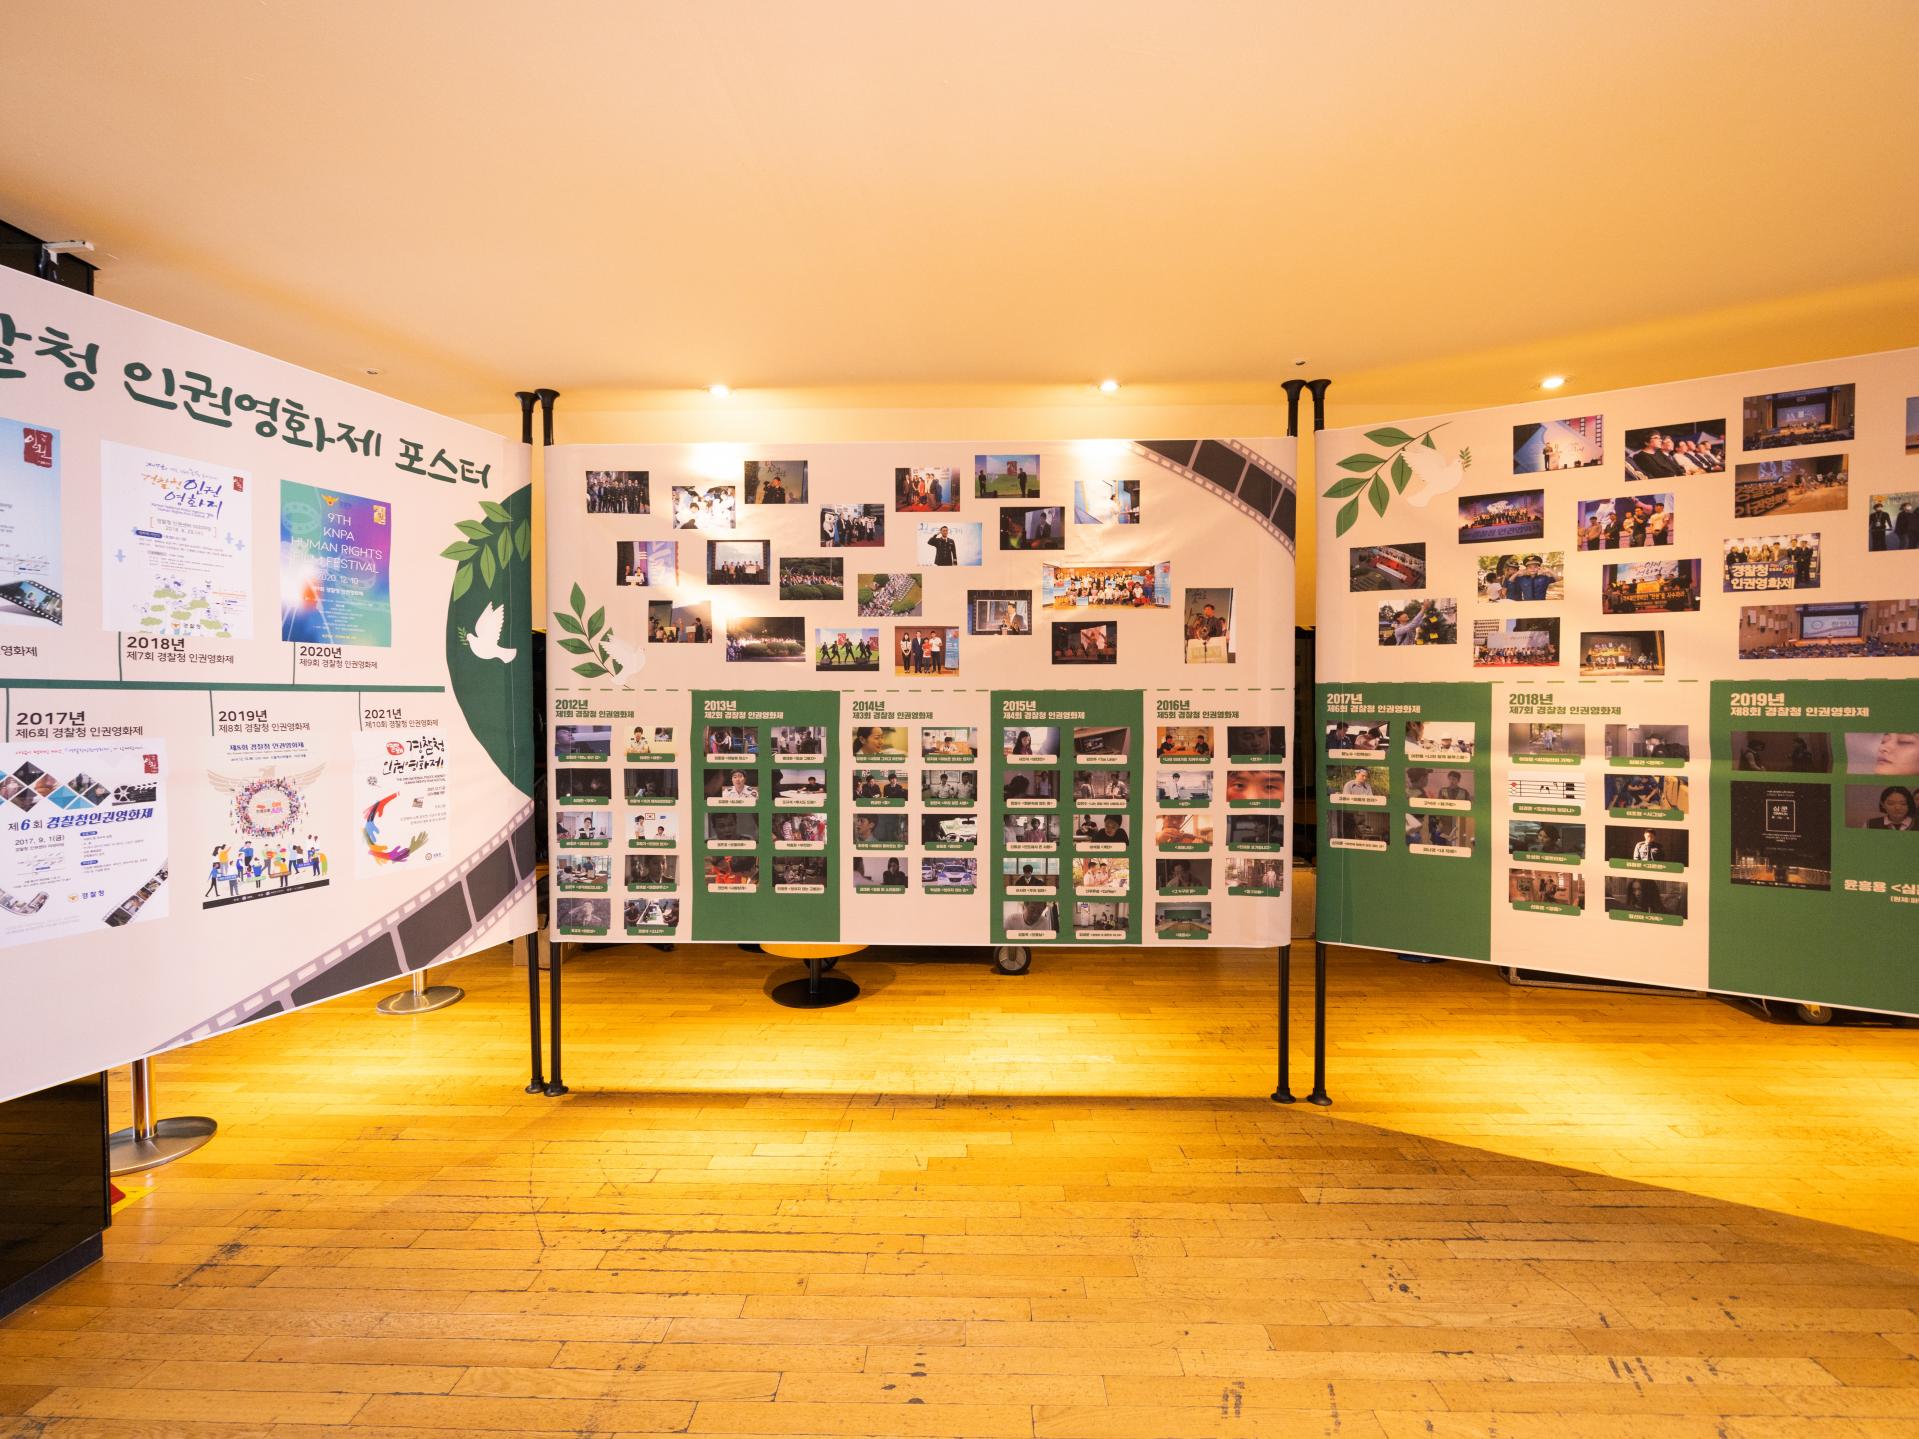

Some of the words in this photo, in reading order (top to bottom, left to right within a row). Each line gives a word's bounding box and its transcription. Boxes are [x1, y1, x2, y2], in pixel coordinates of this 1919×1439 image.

[124, 362, 382, 457] 인권영화제
[395, 438, 491, 488] 포스터
[184, 480, 222, 497] 인권
[165, 491, 222, 520] 영화제
[327, 512, 351, 526] 9TH
[323, 527, 355, 541] KNPA
[291, 536, 338, 553] HUMAN
[341, 544, 383, 560] RIGHTS
[326, 556, 379, 573] FESTIVAL
[1732, 564, 1769, 577] 경찰청
[1731, 577, 1796, 589] 인권영화제
[127, 637, 185, 651] 2018년
[0, 645, 38, 657] 영화제
[300, 646, 341, 659] 2020년
[126, 651, 154, 661] 제7회
[157, 652, 186, 663] 경찰청
[188, 653, 234, 664] 인권영화제
[299, 658, 320, 667] 제9회
[322, 659, 343, 668] 경찰청
[345, 660, 378, 669] 인권영화제
[1327, 693, 1362, 704] 2017년
[1509, 693, 1553, 705] 2018년
[1730, 693, 1784, 706] 2019년
[555, 700, 588, 710] 2012년
[704, 701, 736, 711] 2013년
[852, 701, 885, 711] 2014년
[1003, 701, 1036, 711] 2015년
[1157, 700, 1190, 710] 2016년
[1327, 705, 1348, 713] 제6회
[1350, 705, 1375, 713] 경찰청
[1378, 705, 1421, 713] 인권영화제
[1509, 706, 1534, 714] 제7회
[1536, 706, 1566, 715] 경찰청
[1569, 706, 1621, 715] 인권영화제
[218, 710, 268, 723] 2019년
[365, 708, 402, 720] 2021년
[748, 712, 783, 720] 인권영화제
[1003, 712, 1022, 720] 제4회
[1025, 712, 1046, 720] 경찰청
[1048, 712, 1085, 720] 인권영화제
[1157, 711, 1176, 719] 제5회
[1179, 711, 1200, 719] 경찰청
[1202, 711, 1239, 719] 인권영화제
[1730, 707, 1761, 716] 제8회
[1765, 707, 1801, 717] 경찰청
[1805, 707, 1869, 717] 인권영화제
[16, 711, 85, 726] 2017년
[365, 720, 388, 729] 제10회
[389, 720, 408, 729] 경찰청
[409, 719, 438, 728] 인권영화제
[16, 727, 48, 739] 제6회
[52, 727, 87, 739] 경찰청
[90, 726, 143, 737] 인권영화제
[219, 723, 242, 733] 제8회
[245, 723, 269, 733] 경찰청
[272, 722, 310, 732] 인권영화제
[406, 736, 445, 756] 경찰청
[383, 755, 444, 775] 인권영화제
[46, 807, 154, 829] 경찰청인권영화제
